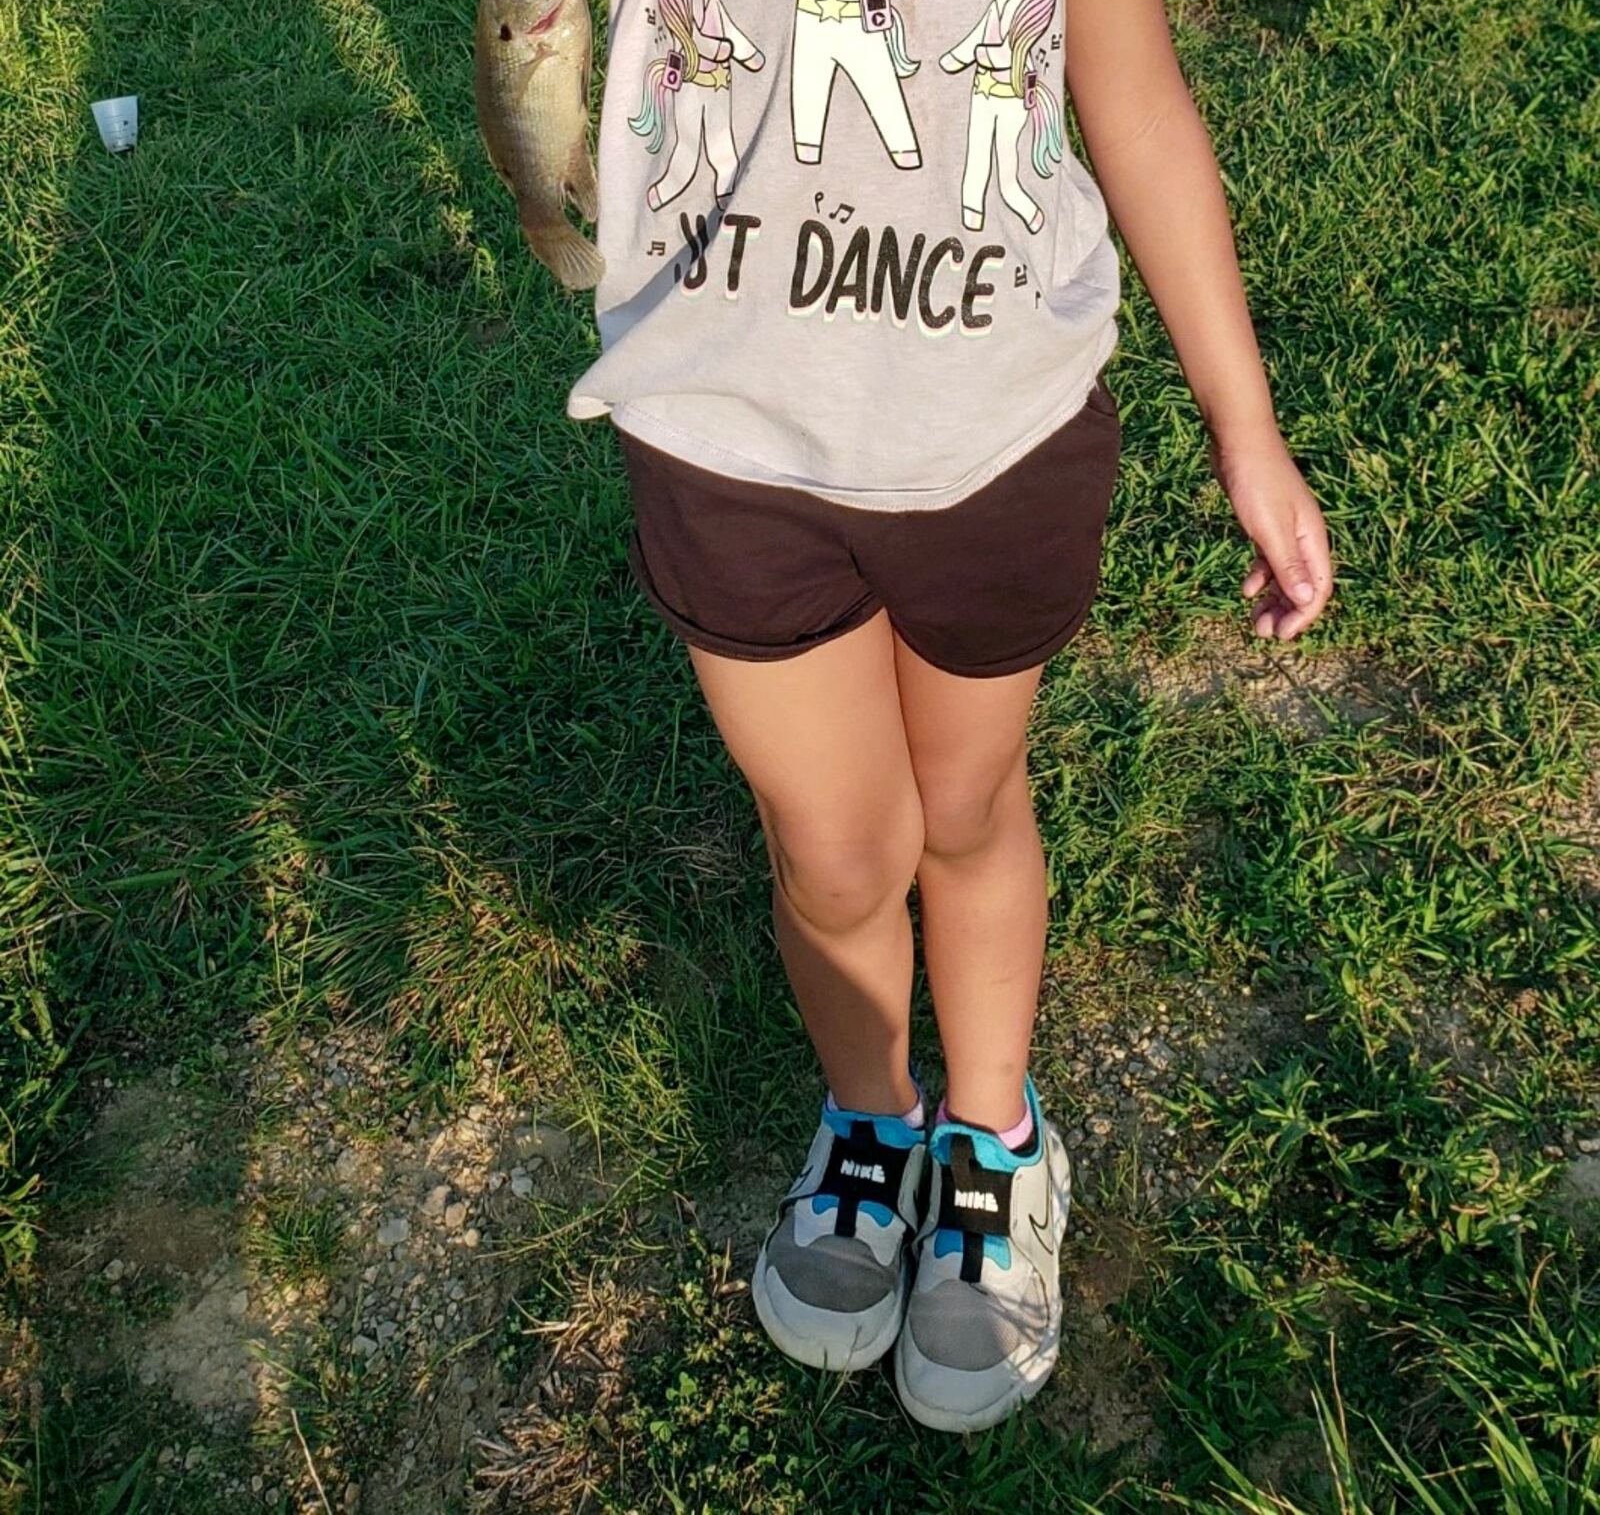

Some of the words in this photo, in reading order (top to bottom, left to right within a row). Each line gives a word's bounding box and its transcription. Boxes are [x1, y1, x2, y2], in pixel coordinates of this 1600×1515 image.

[788, 219, 1006, 330] DANCE
[840, 1159, 886, 1184] NIKE
[954, 1188, 999, 1213] NIKE
